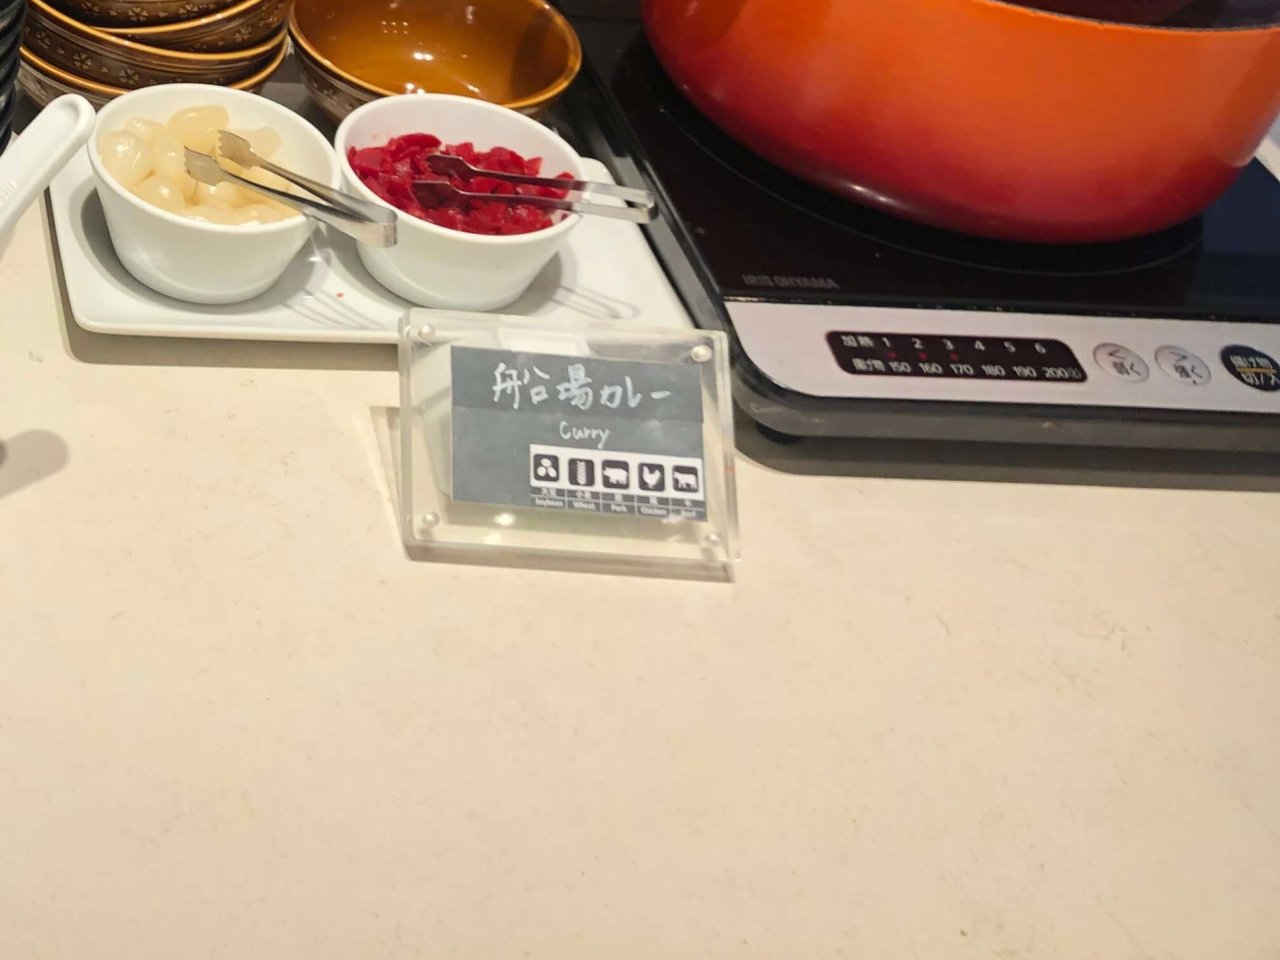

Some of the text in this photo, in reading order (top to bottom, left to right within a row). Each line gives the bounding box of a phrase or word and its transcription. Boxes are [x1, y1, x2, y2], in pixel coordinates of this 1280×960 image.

[888, 361, 912, 373] 150
[919, 362, 943, 374] 160
[950, 363, 974, 376] 170
[981, 364, 1006, 377] 180
[1012, 365, 1037, 378] 190
[559, 420, 610, 449] Curry
